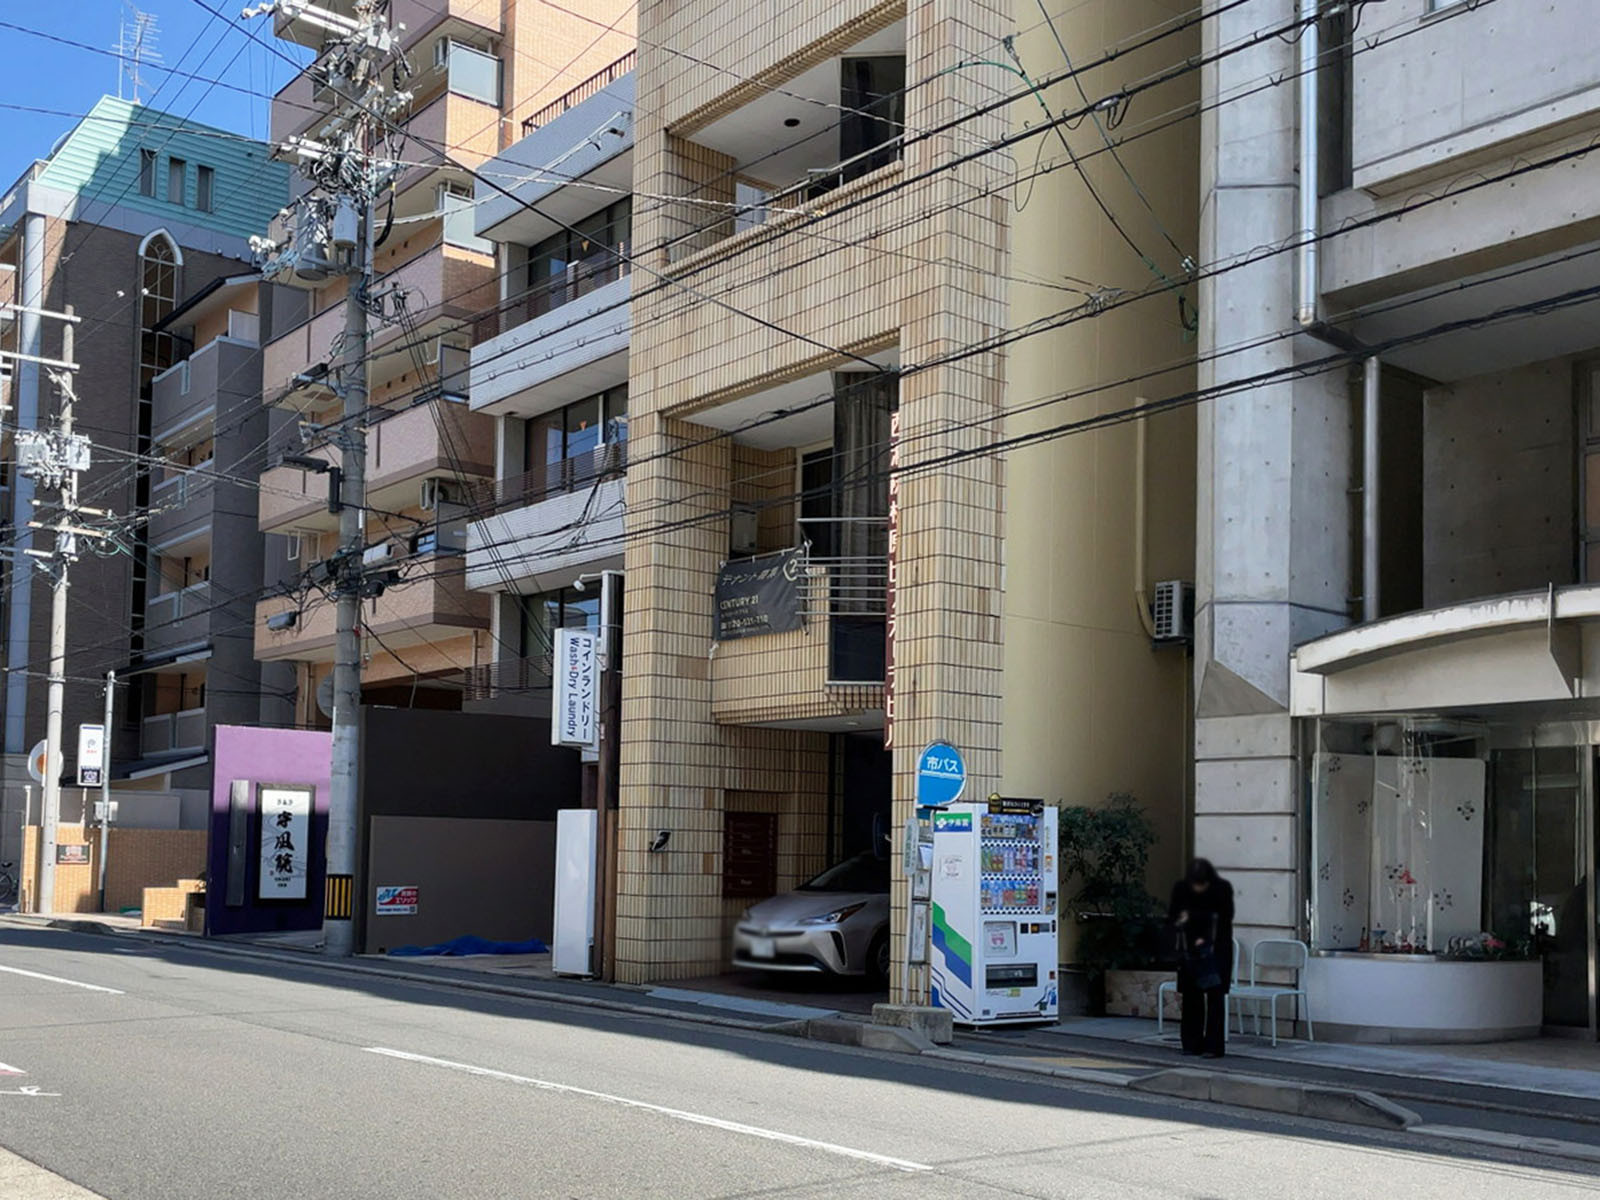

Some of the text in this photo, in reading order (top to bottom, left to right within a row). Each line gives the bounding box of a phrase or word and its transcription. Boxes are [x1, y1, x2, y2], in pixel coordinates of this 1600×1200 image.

[581, 638, 592, 739] コインランドリー
[566, 693, 579, 738] Laundry
[926, 756, 959, 773] 市バス
